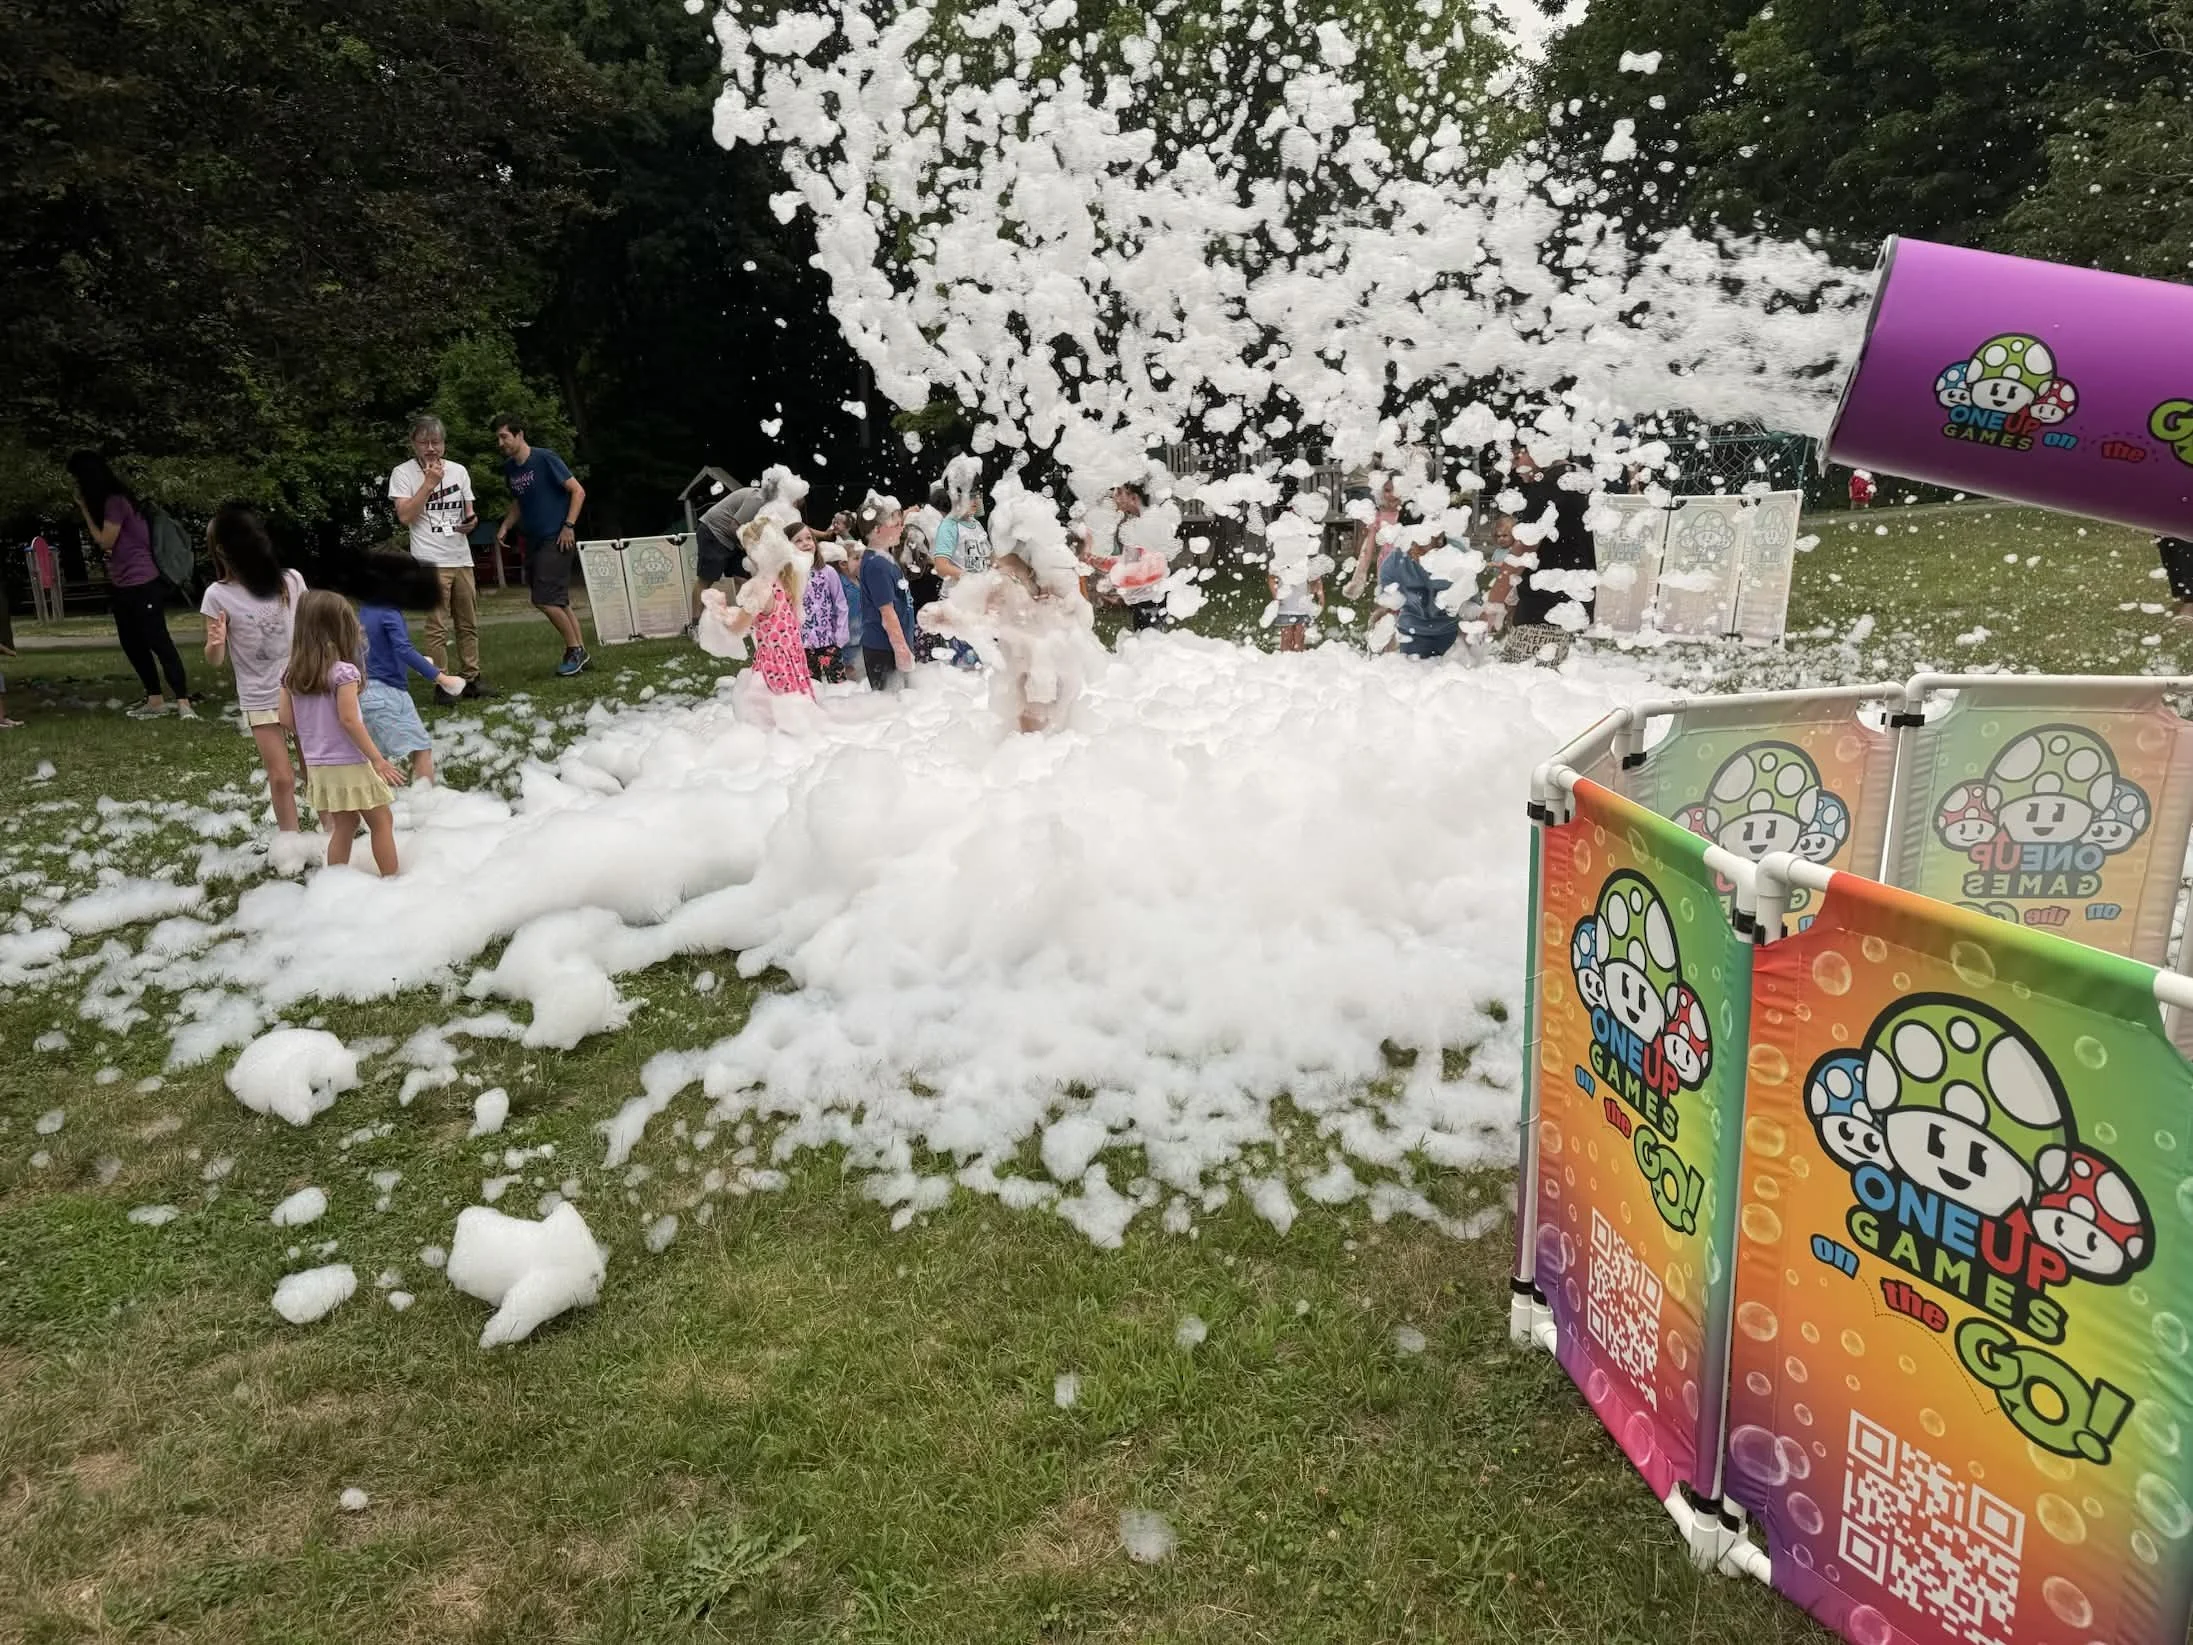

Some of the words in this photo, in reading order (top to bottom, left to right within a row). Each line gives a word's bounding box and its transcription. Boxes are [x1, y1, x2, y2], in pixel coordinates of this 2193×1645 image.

[1942, 423, 2033, 451] GAMES
[2042, 432, 2079, 450] on
[2102, 440, 2147, 463] the
[1575, 1063, 1595, 1099] on
[1604, 1096, 1631, 1139] the
[1634, 1124, 1704, 1235] GO!
[1590, 1043, 1678, 1140] GAMES
[1848, 1209, 2066, 1343] GAMES
[1810, 1233, 1860, 1280] on
[1880, 1276, 1949, 1333] the
[1954, 1316, 2135, 1466] GO!
